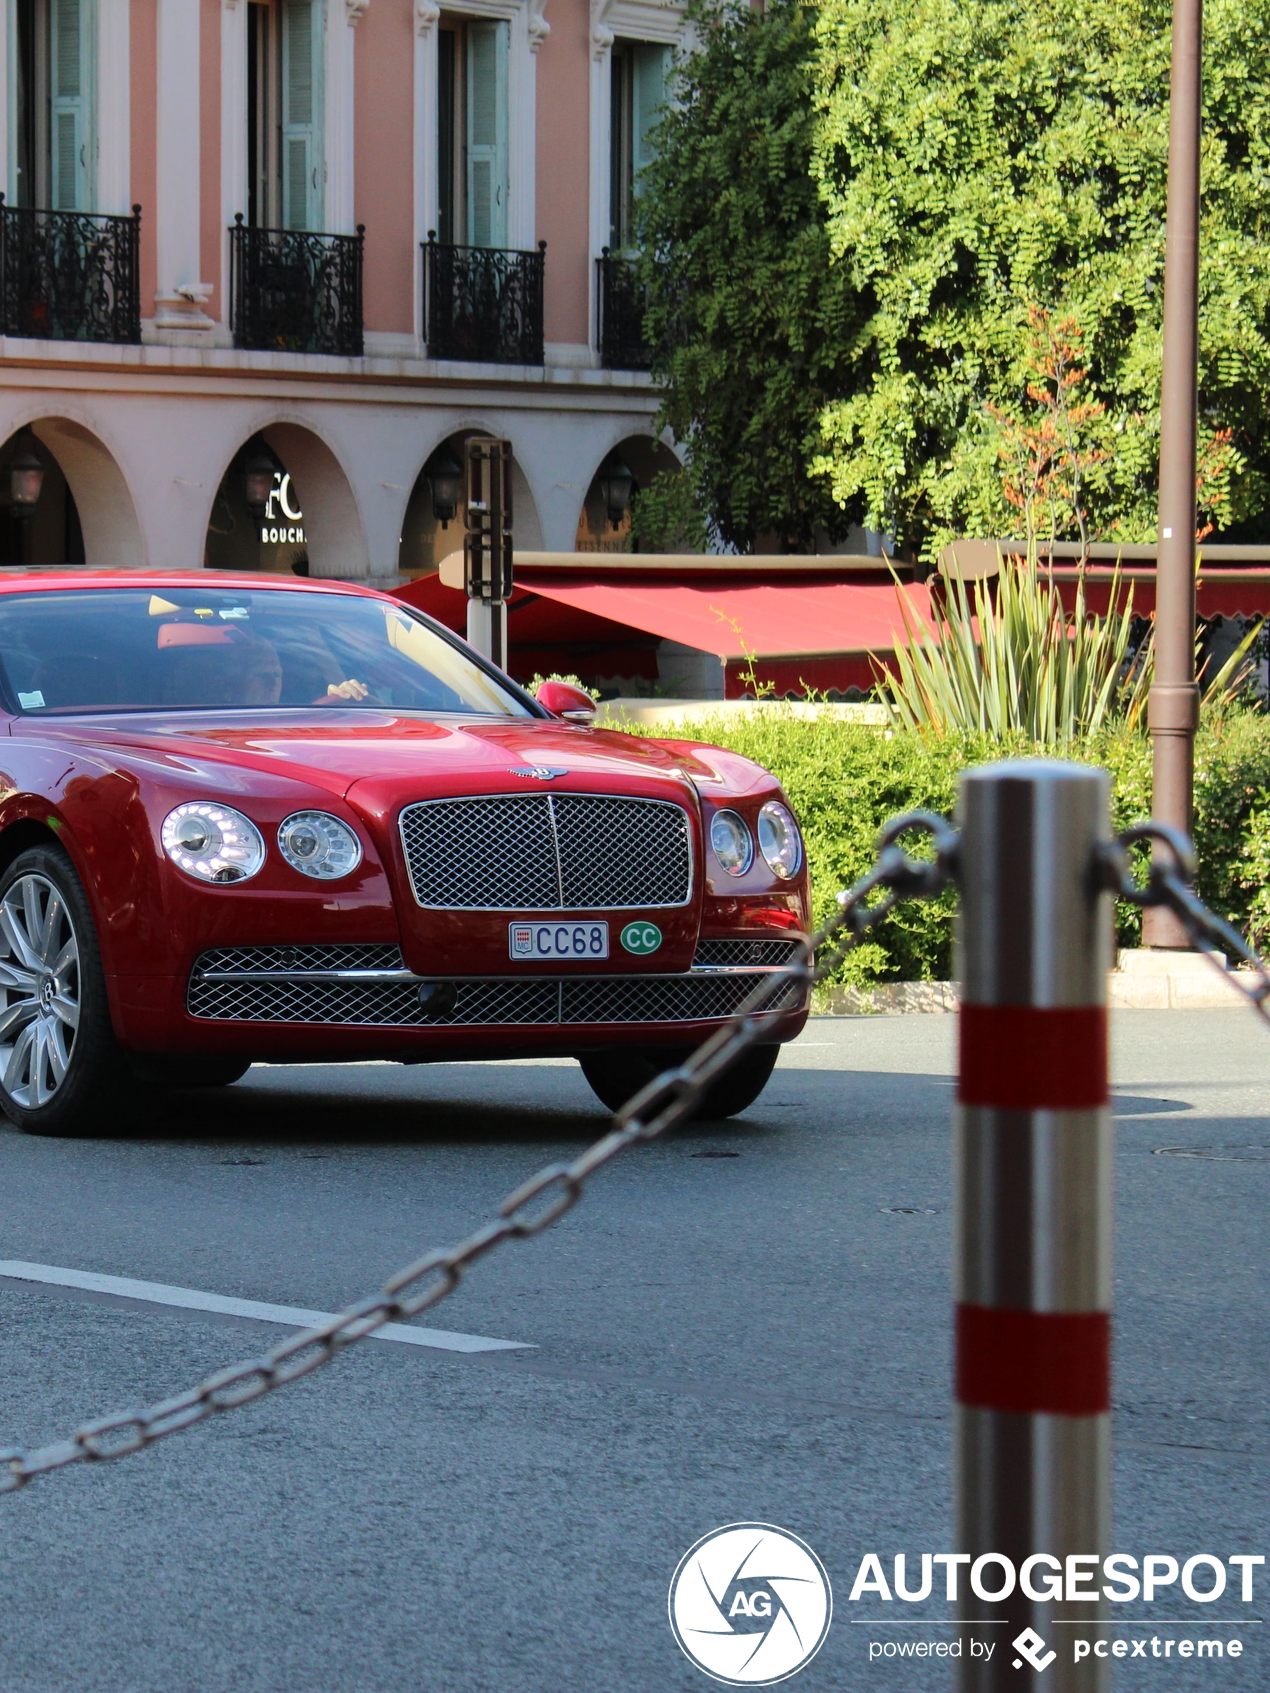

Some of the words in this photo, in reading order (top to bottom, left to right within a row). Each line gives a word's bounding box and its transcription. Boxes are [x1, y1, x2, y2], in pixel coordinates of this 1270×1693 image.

[261, 527, 308, 544] BOUCH
[537, 927, 603, 954] CC68
[626, 928, 656, 948] CC
